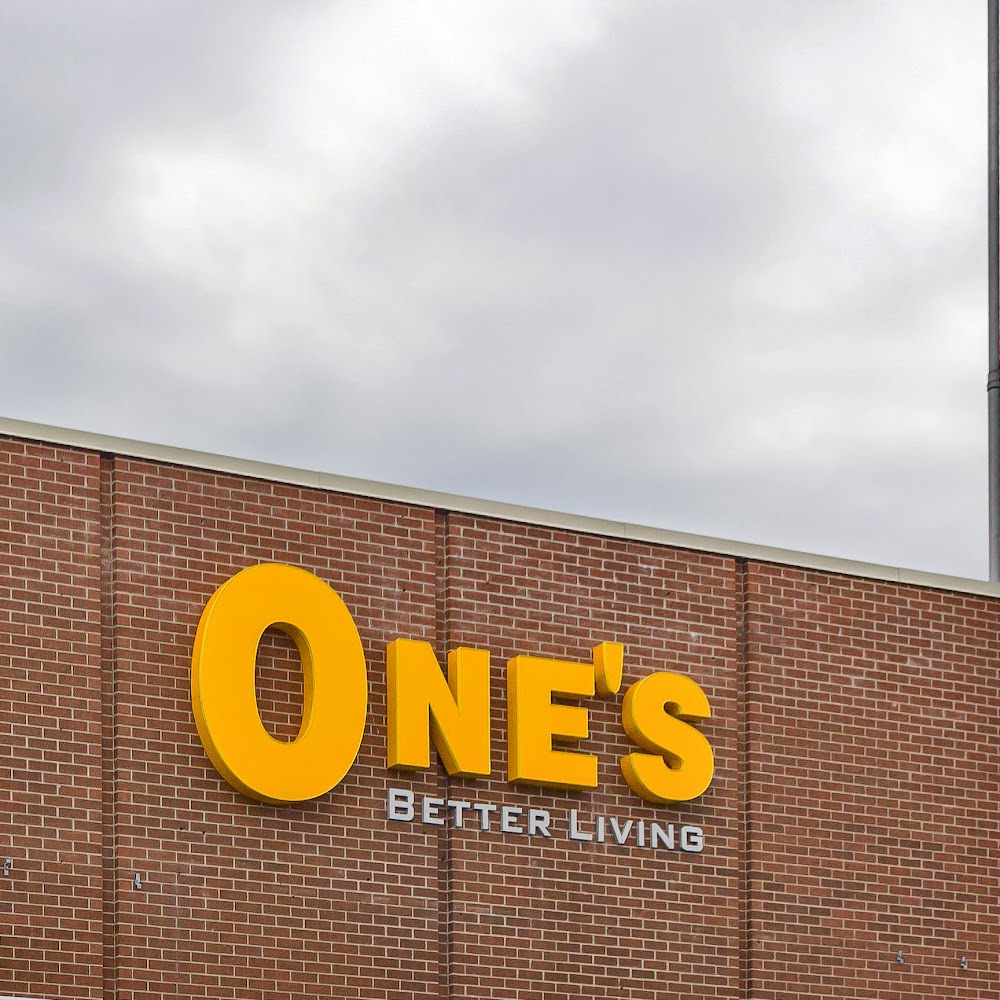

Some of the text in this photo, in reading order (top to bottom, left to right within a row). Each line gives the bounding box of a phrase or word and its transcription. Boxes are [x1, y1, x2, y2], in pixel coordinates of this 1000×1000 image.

[191, 563, 714, 804] ONE'S
[387, 788, 704, 852] BETTER LIVING
